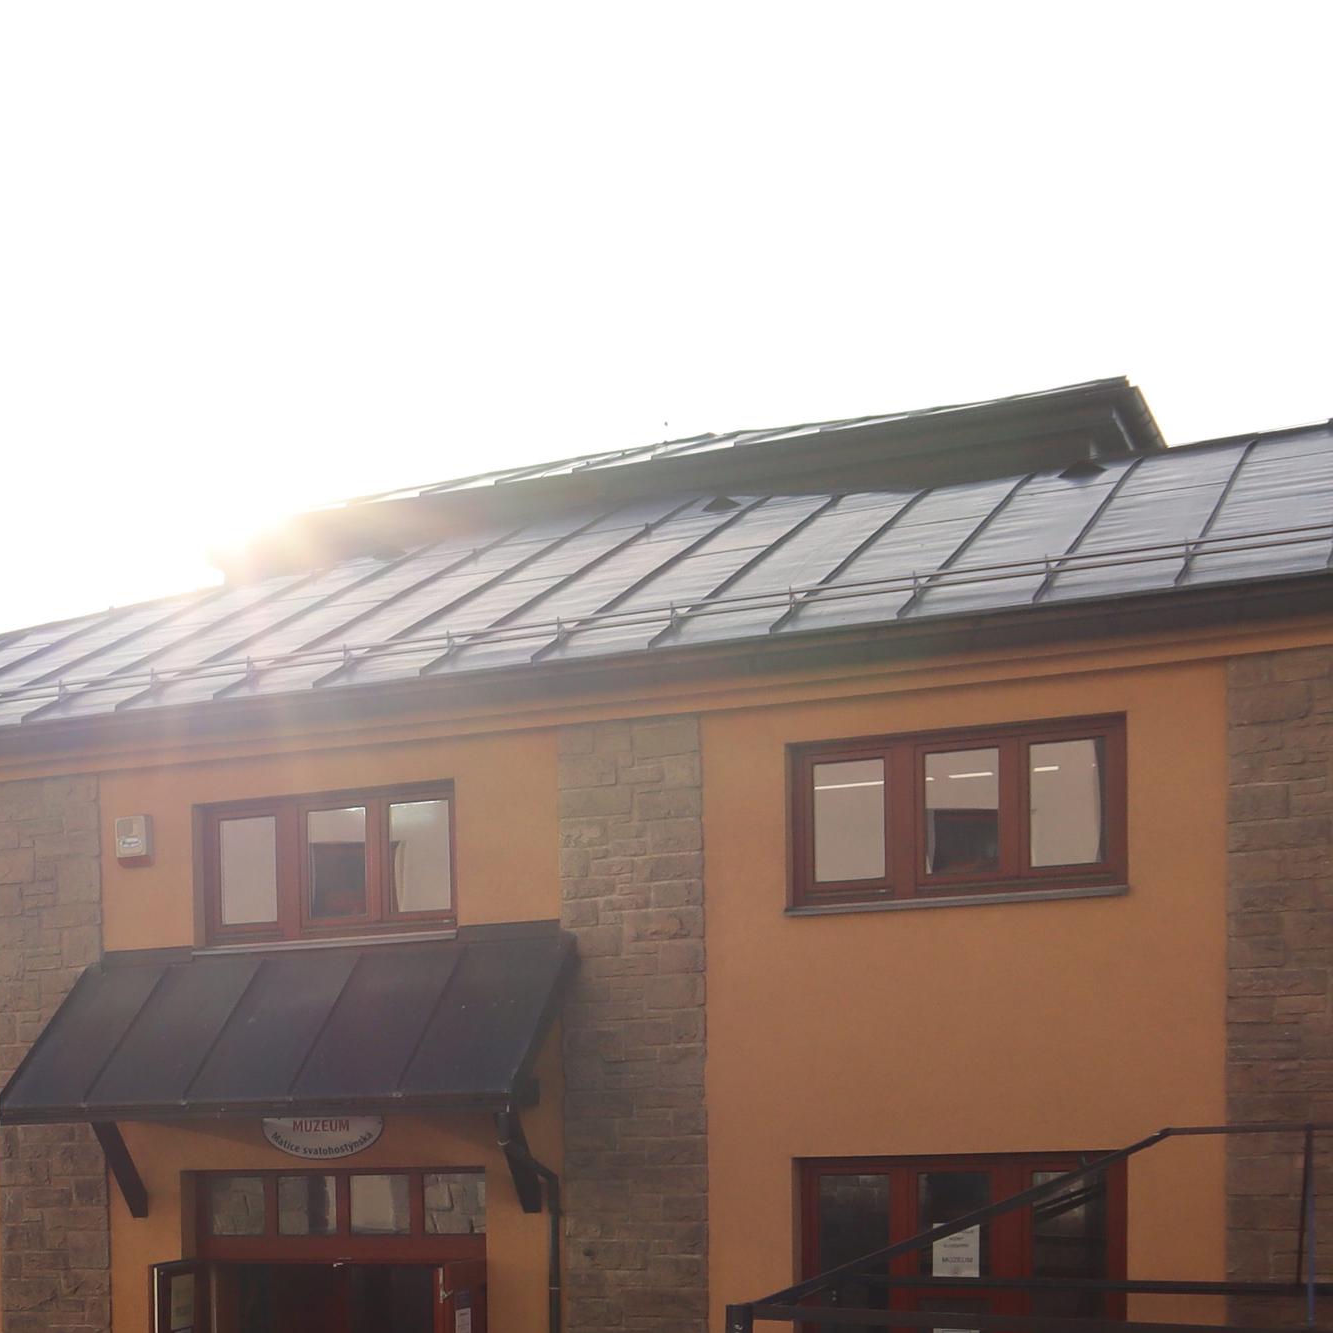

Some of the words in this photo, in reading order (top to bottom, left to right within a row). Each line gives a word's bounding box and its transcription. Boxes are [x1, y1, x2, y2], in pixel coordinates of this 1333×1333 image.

[293, 1119, 350, 1132] MUZEUM
[271, 1131, 301, 1153] Matice
[302, 1132, 374, 1156] svatohostýnská
